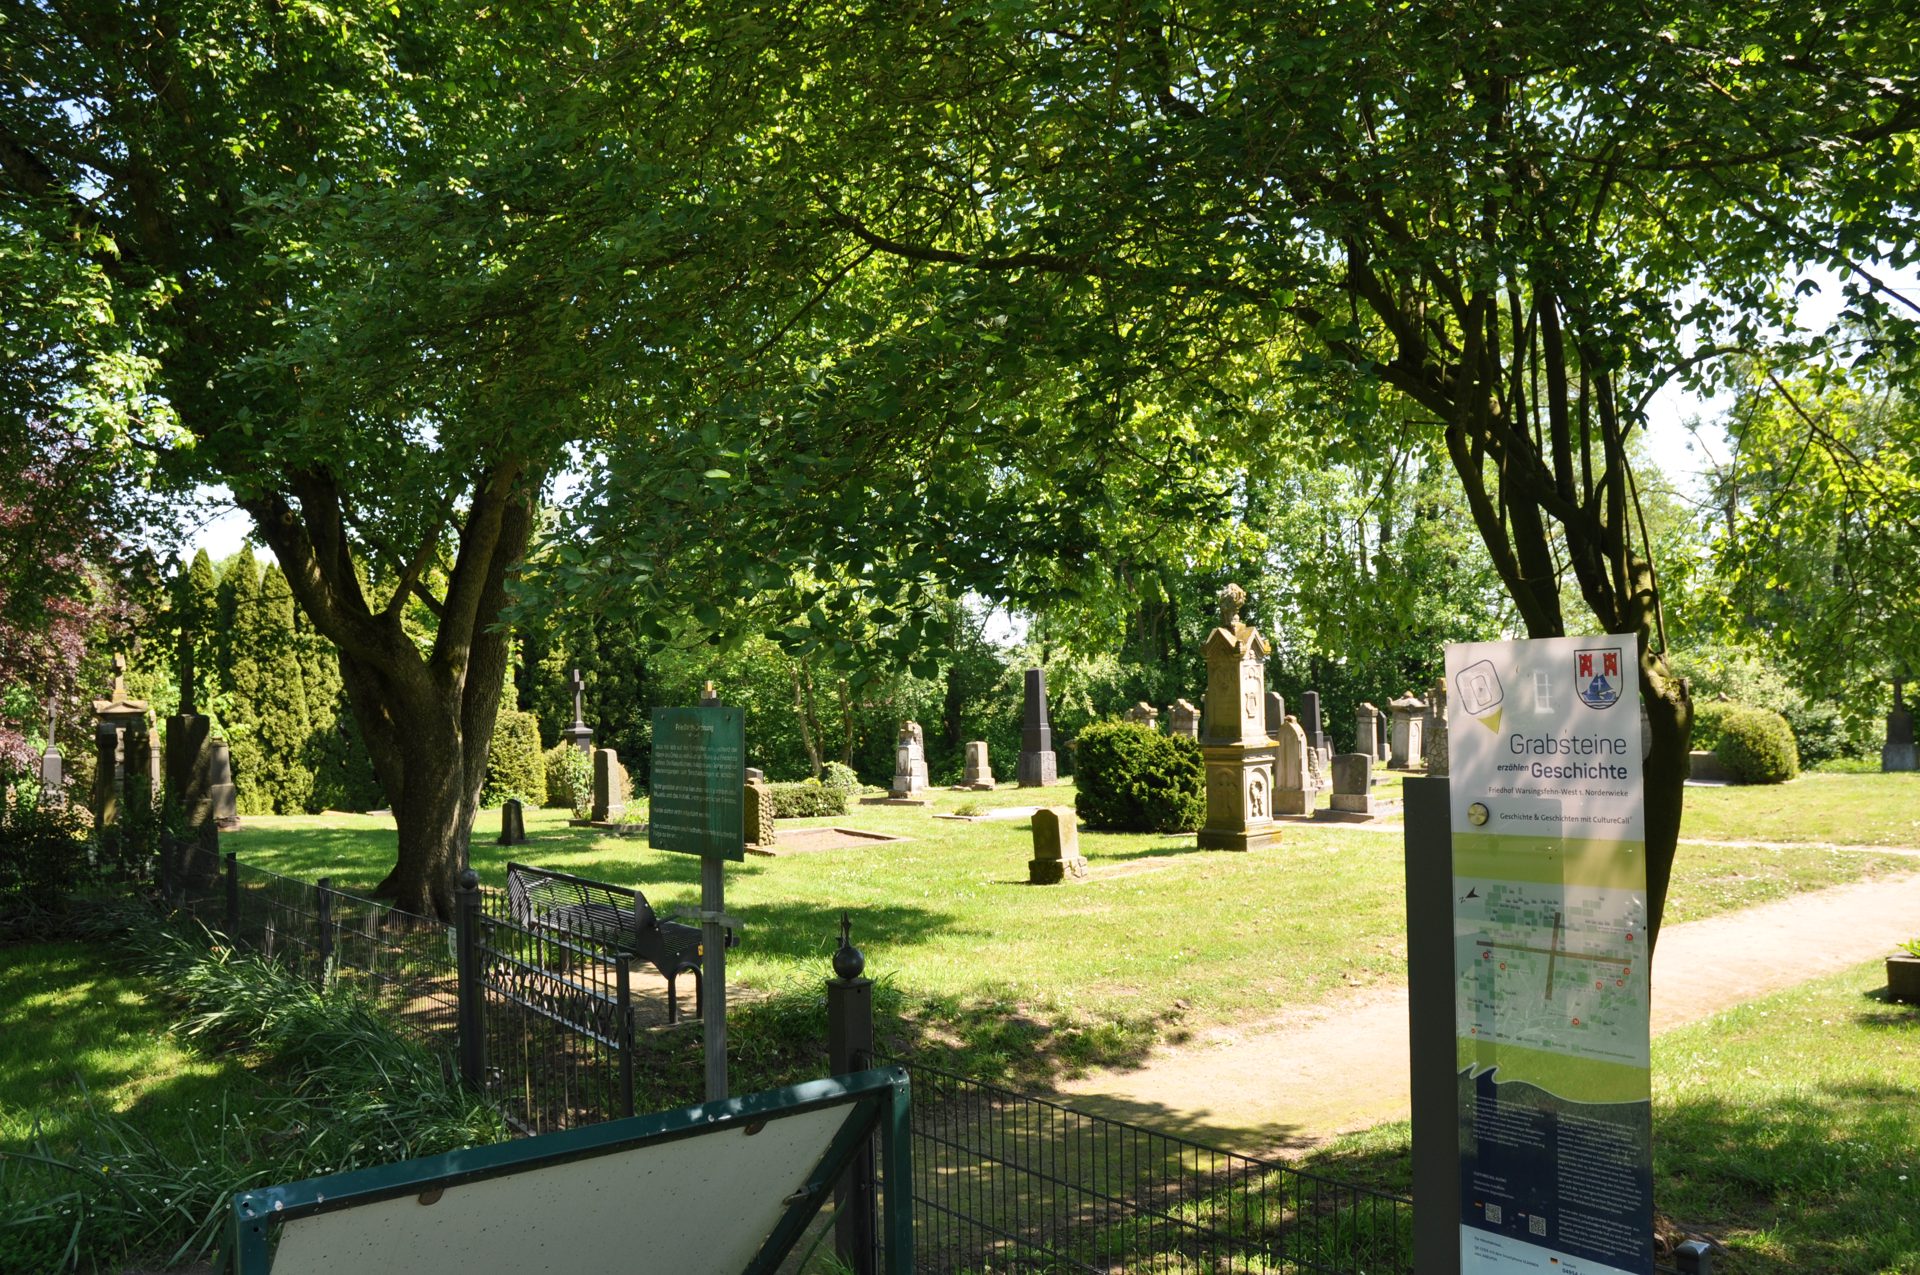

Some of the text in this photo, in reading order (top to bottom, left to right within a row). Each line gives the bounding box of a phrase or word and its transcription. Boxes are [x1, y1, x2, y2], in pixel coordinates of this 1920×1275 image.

[1510, 733, 1627, 755] Grabsteine
[1531, 762, 1628, 780] Geschichte
[1515, 787, 1578, 796] Warsingsfehn-West
[1585, 789, 1629, 797] Norderwieke
[1499, 812, 1533, 820] Geschichte
[1540, 814, 1579, 823] Geschichten
[1592, 816, 1633, 825] CultureCall
